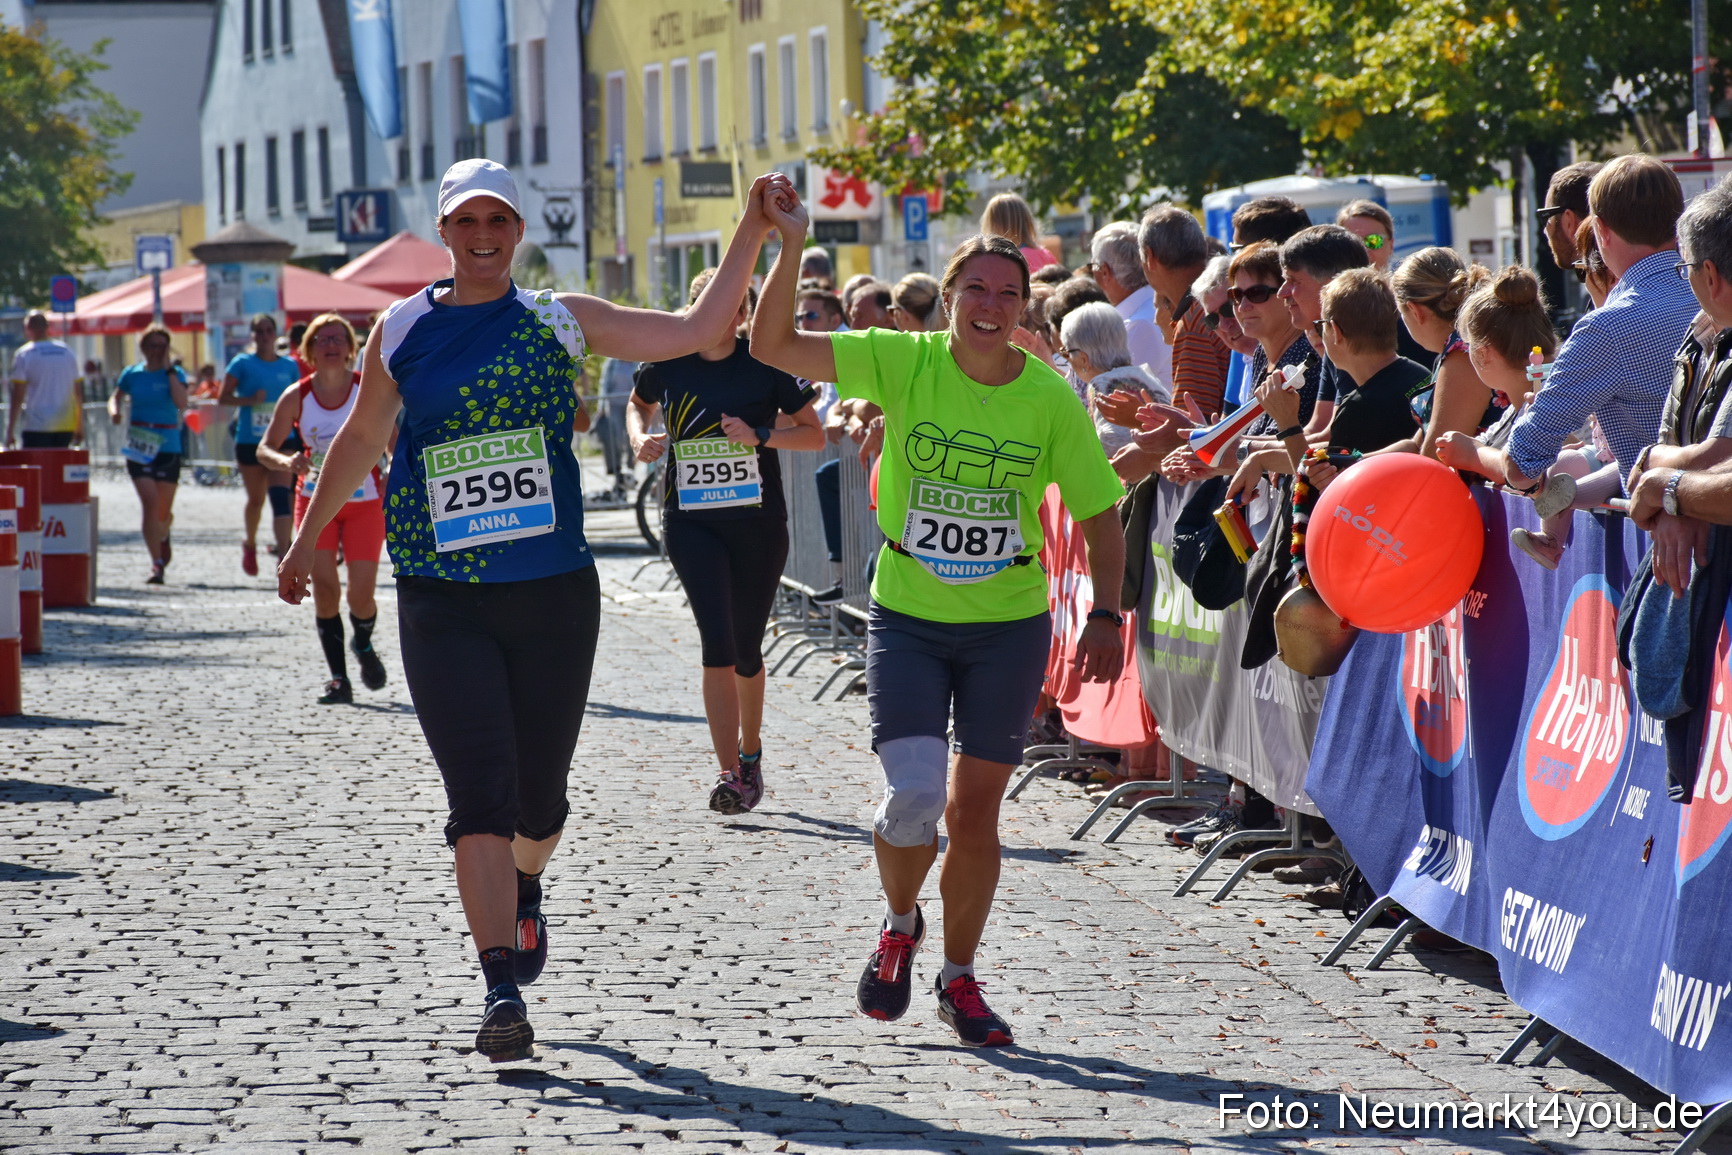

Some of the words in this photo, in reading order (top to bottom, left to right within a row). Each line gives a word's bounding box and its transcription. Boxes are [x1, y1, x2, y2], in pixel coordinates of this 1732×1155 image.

[650, 10, 685, 51] HOTEL
[908, 201, 923, 238] P
[433, 433, 536, 474] BOCK
[680, 440, 749, 459] BOCK
[441, 467, 537, 513] 2596
[686, 460, 749, 485] 2595
[701, 489, 738, 501] JULIA
[918, 484, 1011, 517] BOCK
[468, 512, 521, 534] ANNA
[916, 518, 1008, 557] 2087
[928, 561, 997, 576] ANNINA
[1365, 538, 1403, 567] energie
[1536, 634, 1626, 783] Hervis
[1640, 712, 1664, 747] ONLINE
[1532, 755, 1575, 792] SPORTS
[1622, 784, 1651, 820] MOBILE
[1501, 886, 1535, 953] GET
